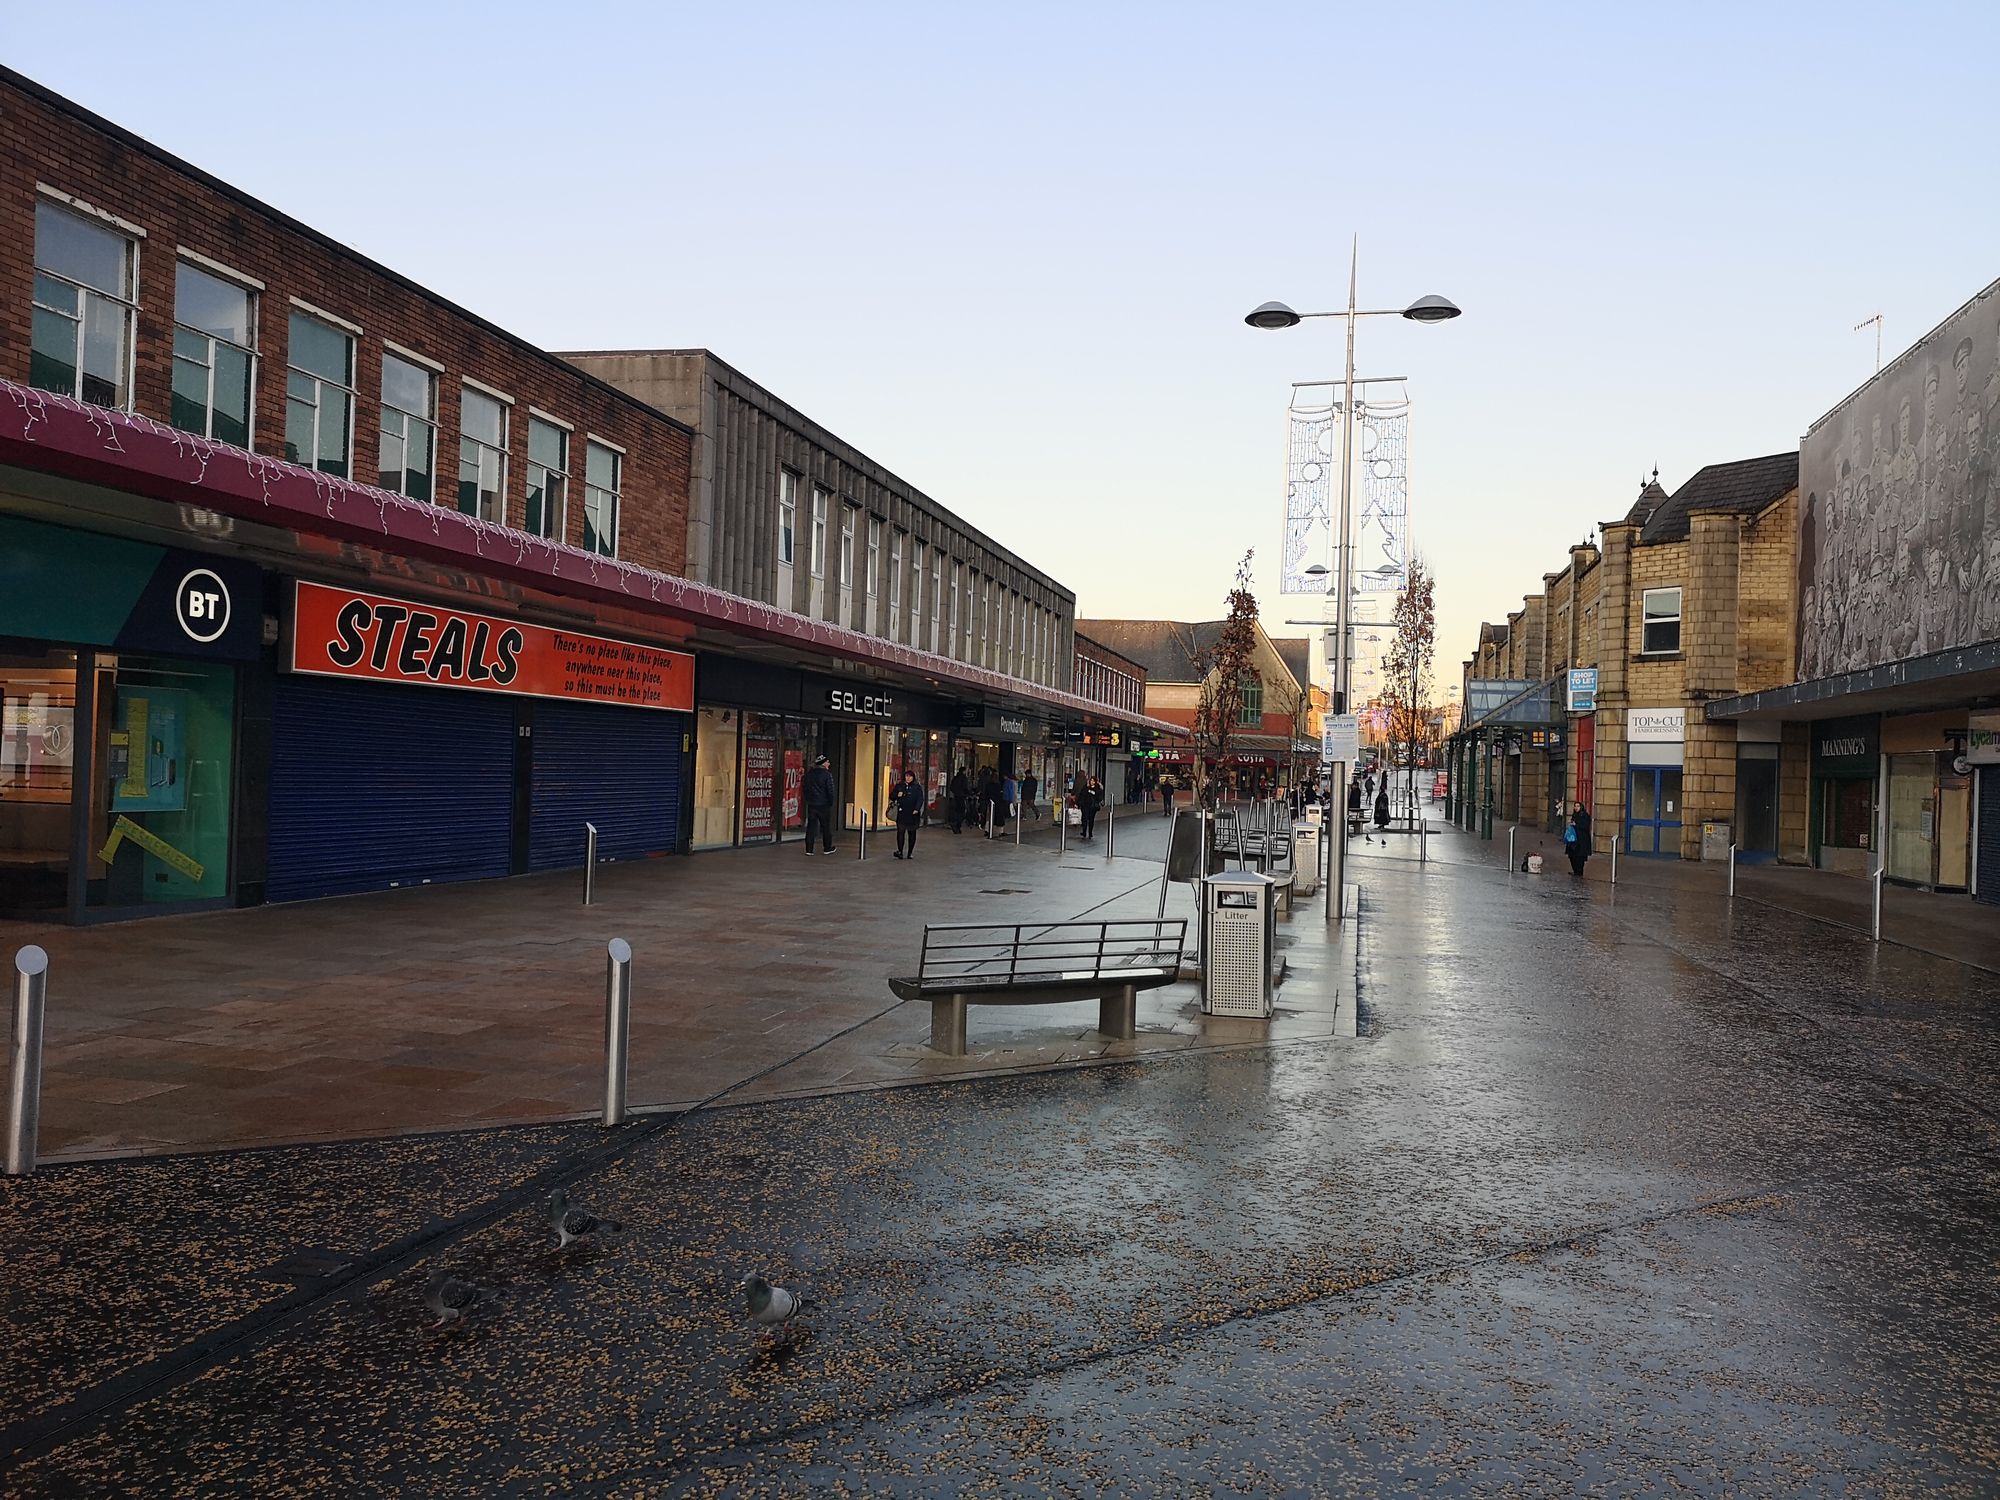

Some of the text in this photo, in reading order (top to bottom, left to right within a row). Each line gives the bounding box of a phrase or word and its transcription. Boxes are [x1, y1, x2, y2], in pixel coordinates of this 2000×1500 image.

[189, 590, 219, 620] BT
[326, 598, 524, 685] STEALS
[552, 634, 673, 670] There's no place like this place,
[565, 660, 663, 686] anywhere near this place,
[564, 678, 661, 703] so this must be the place
[1632, 716, 1684, 727] TOP CUT
[748, 747, 773, 760] MASSIVE
[1821, 737, 1865, 757] MANNING'S
[908, 749, 922, 763] SALE
[1237, 753, 1265, 763] COSTA
[747, 759, 773, 769] CLEARANCE
[747, 777, 772, 789] MASSIVE
[746, 789, 772, 798] CLEARANCE
[746, 806, 771, 819] MASSIVE
[745, 819, 770, 828] CLEARANCE
[1224, 911, 1249, 920] Litter
